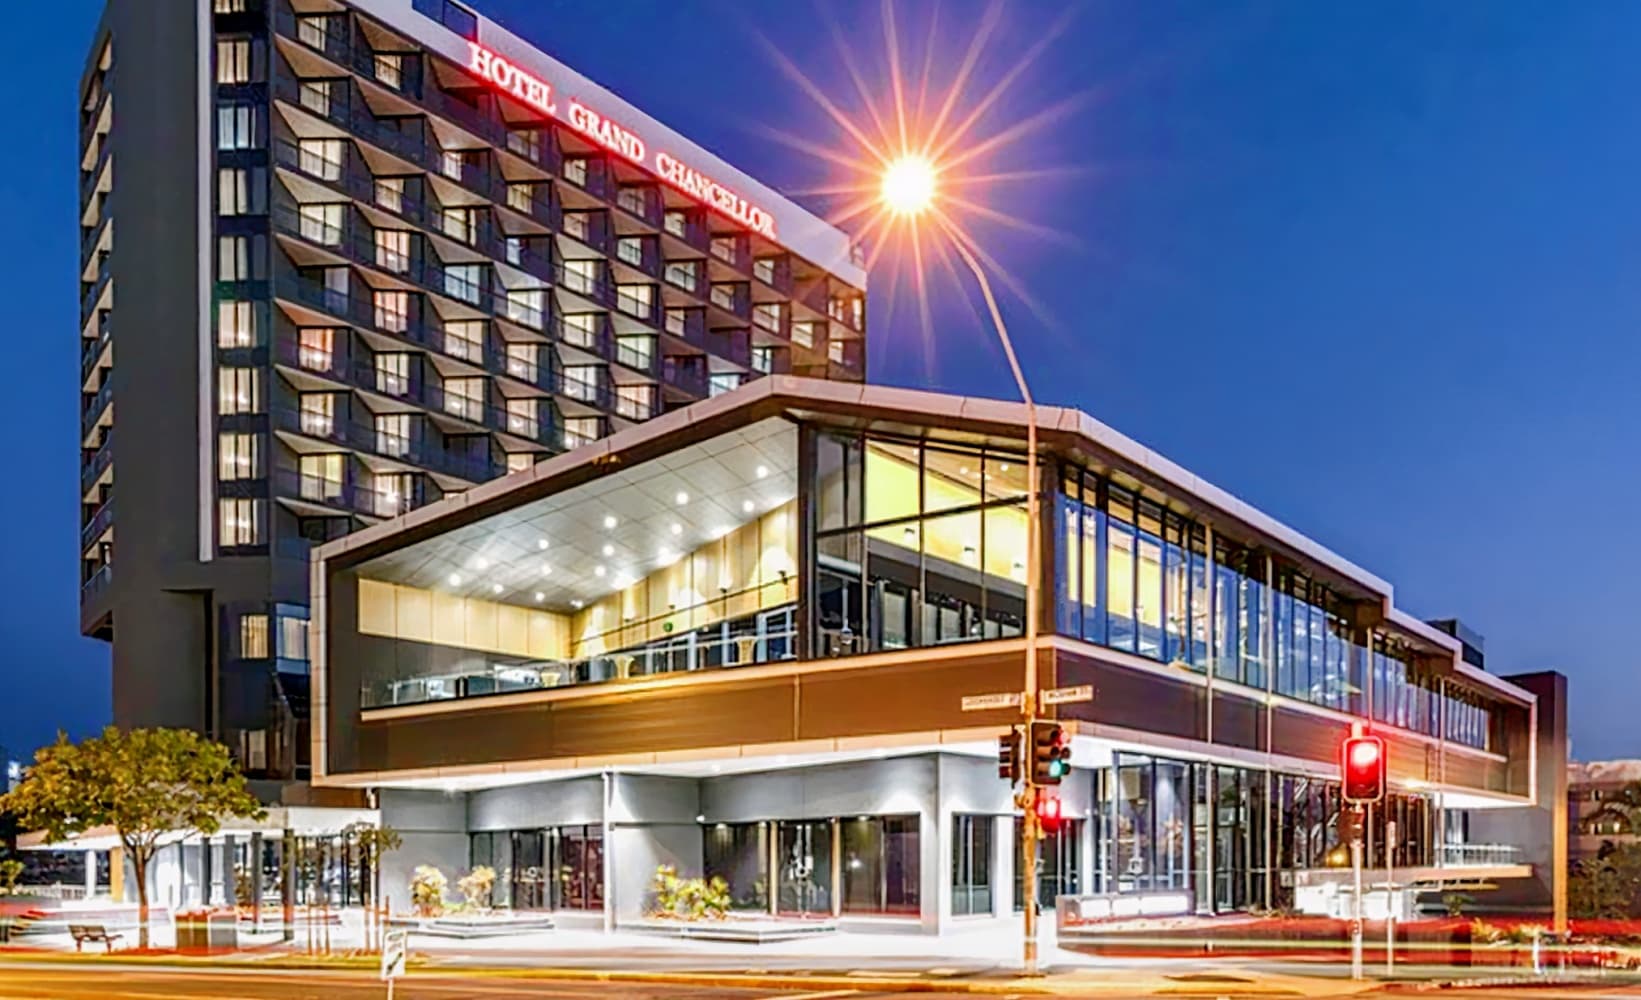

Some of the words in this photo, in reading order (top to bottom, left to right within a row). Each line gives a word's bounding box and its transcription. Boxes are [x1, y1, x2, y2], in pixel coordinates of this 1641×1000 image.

[468, 41, 556, 114] HOTEL
[568, 103, 645, 162] GRAND
[656, 153, 777, 239] CHANCELLOR
